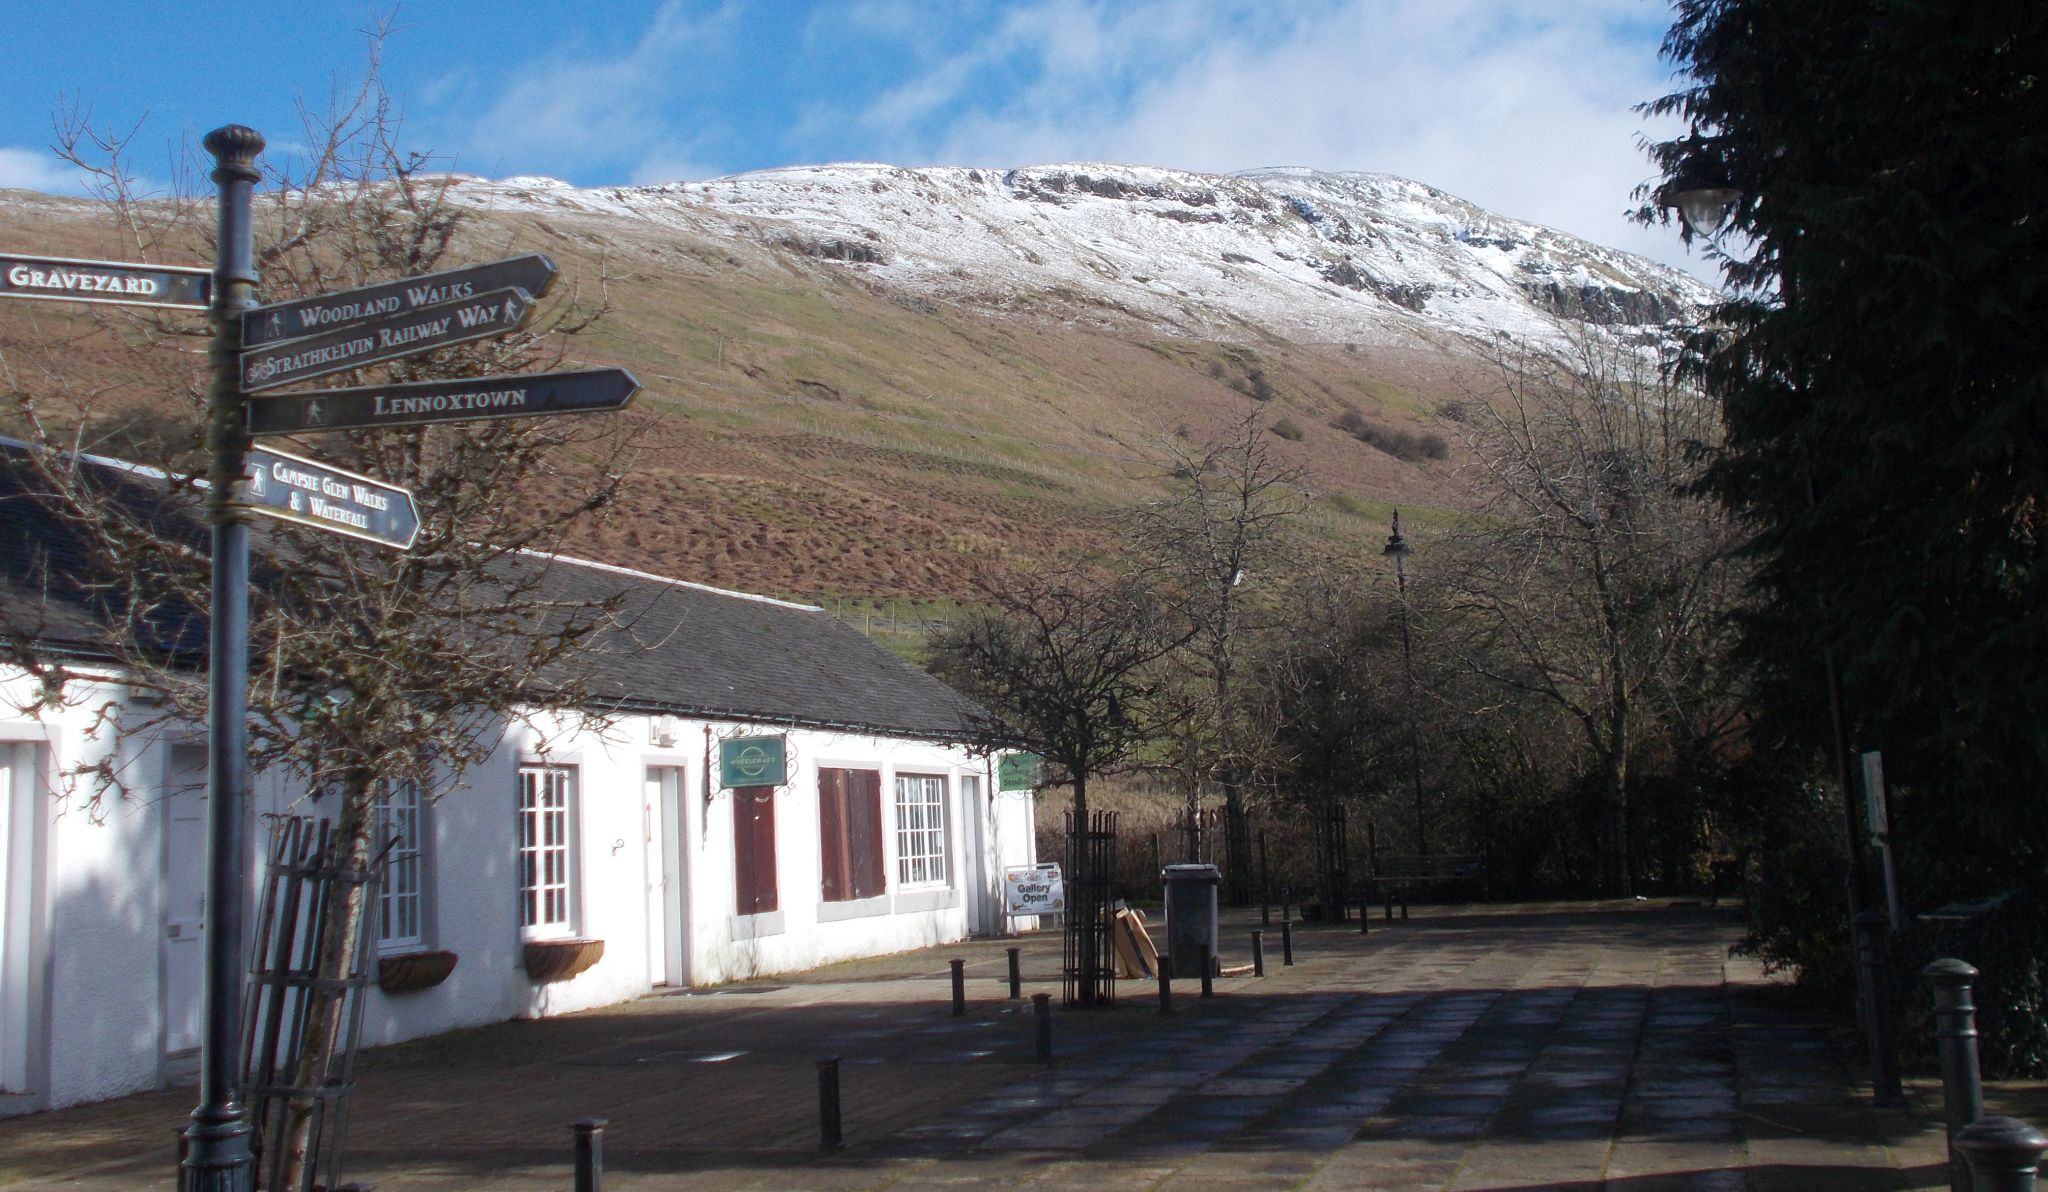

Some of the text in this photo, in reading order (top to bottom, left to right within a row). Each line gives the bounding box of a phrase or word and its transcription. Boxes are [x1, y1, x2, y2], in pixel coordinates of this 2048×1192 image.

[290, 491, 300, 511] &
[1018, 884, 1051, 894] Gallery
[1023, 894, 1048, 904] Open
